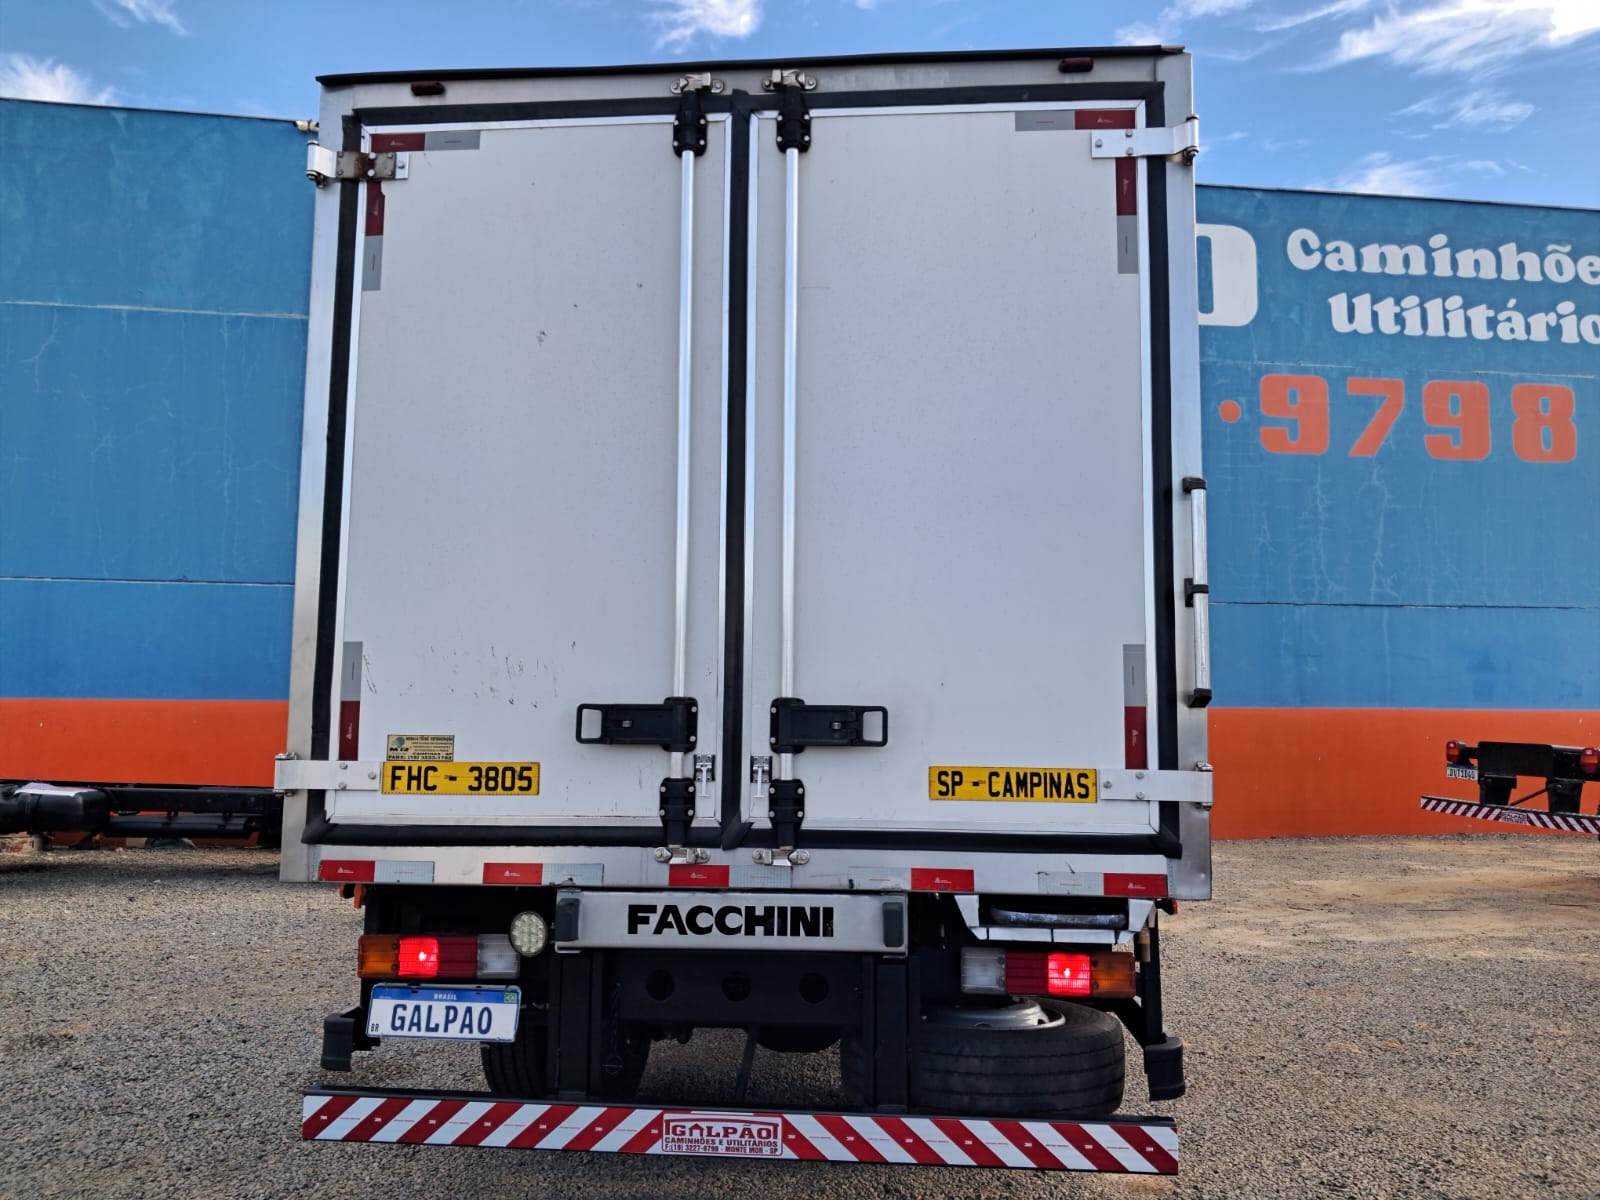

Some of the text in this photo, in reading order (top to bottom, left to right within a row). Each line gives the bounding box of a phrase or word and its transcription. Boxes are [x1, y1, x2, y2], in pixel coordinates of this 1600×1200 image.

[390, 765, 438, 791] FHC
[468, 766, 532, 792] 3805
[937, 770, 963, 797] SP
[988, 771, 1090, 799] CAMPINAS
[627, 904, 834, 937] FACCHINI
[433, 993, 458, 1001] BRASIL
[390, 1003, 493, 1035] GALPAO
